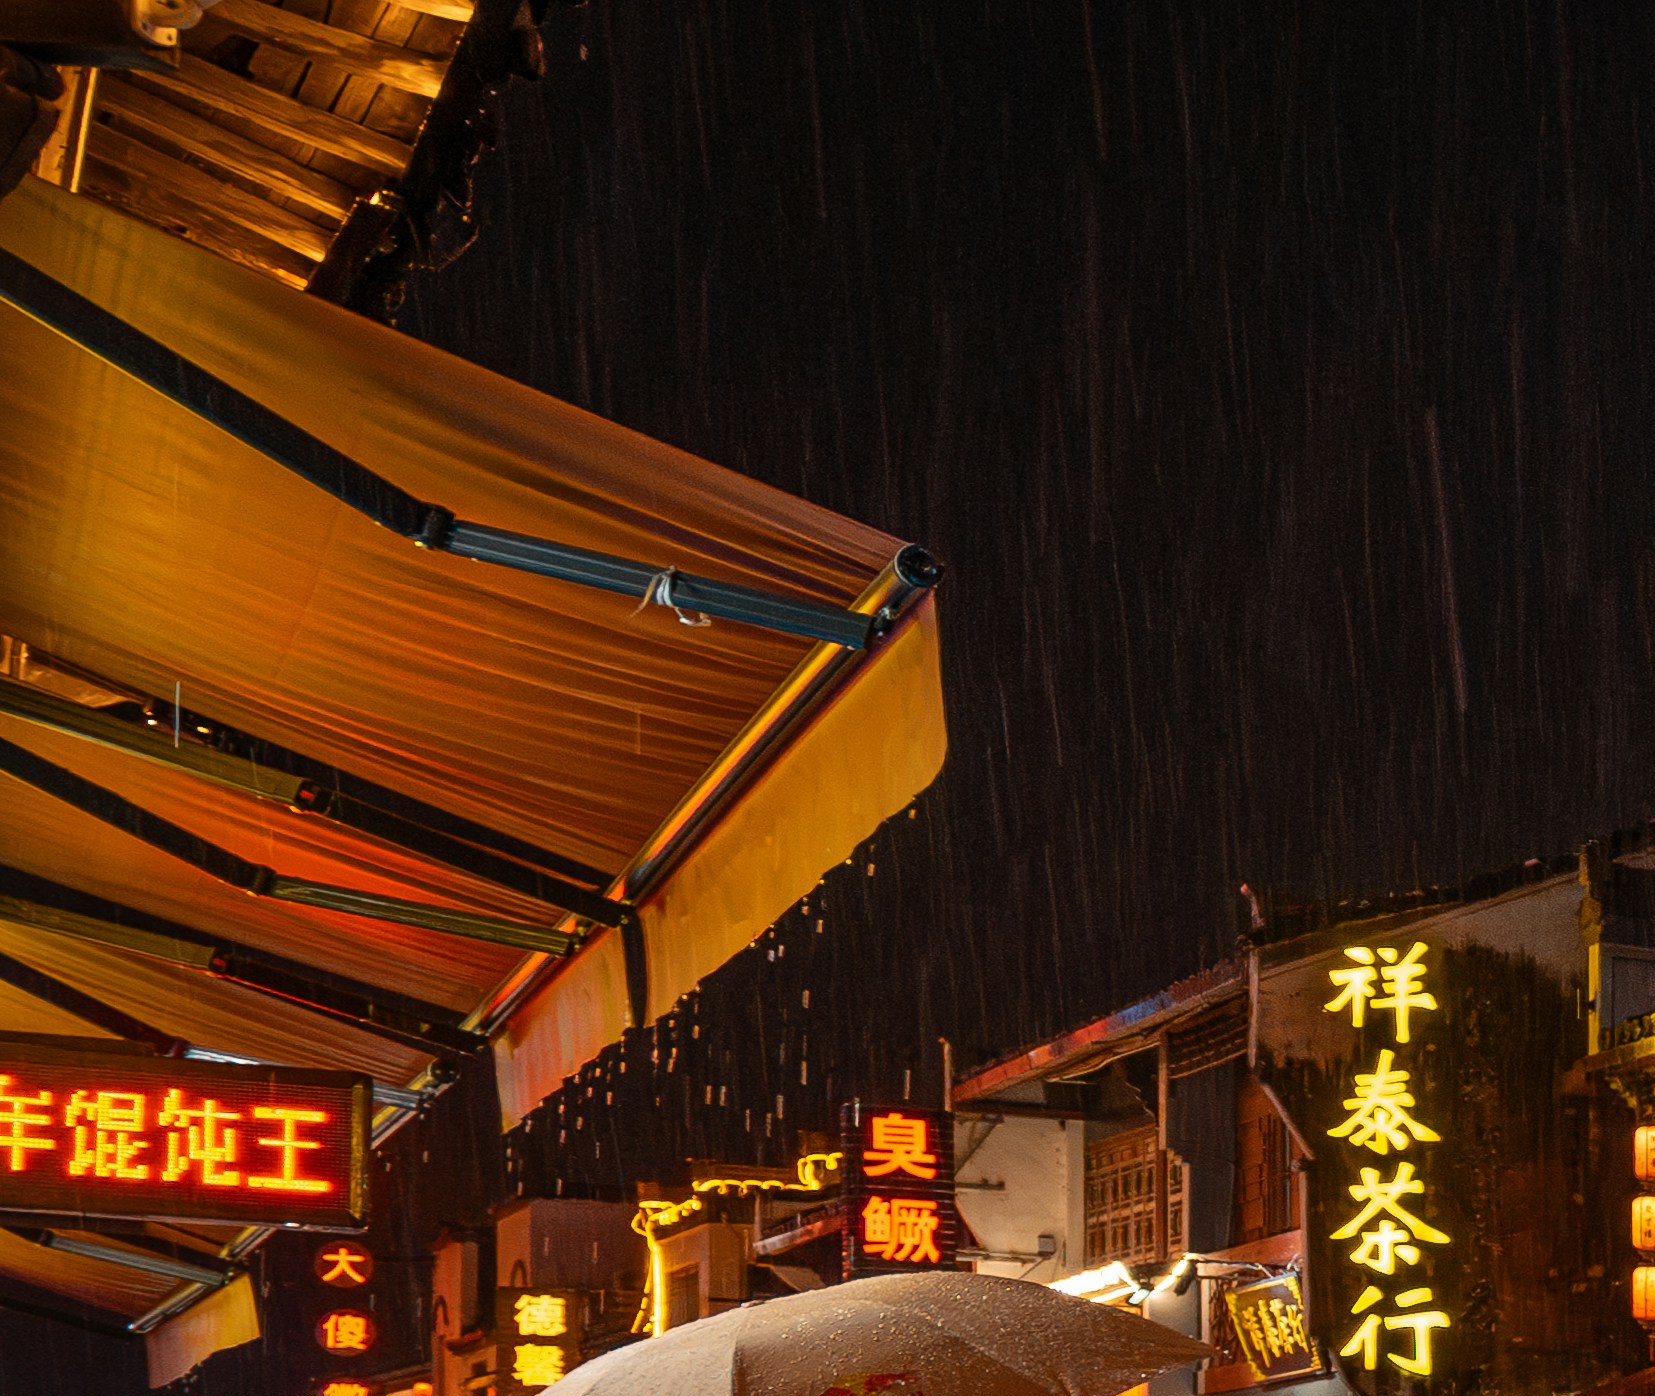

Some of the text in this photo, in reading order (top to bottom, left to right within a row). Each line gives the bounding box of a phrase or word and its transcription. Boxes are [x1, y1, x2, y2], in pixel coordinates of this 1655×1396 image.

[0, 1074, 333, 1193] 年馄饨王
[862, 1113, 942, 1264] 臭鳜
[1323, 940, 1452, 1377] 祥泰茶行
